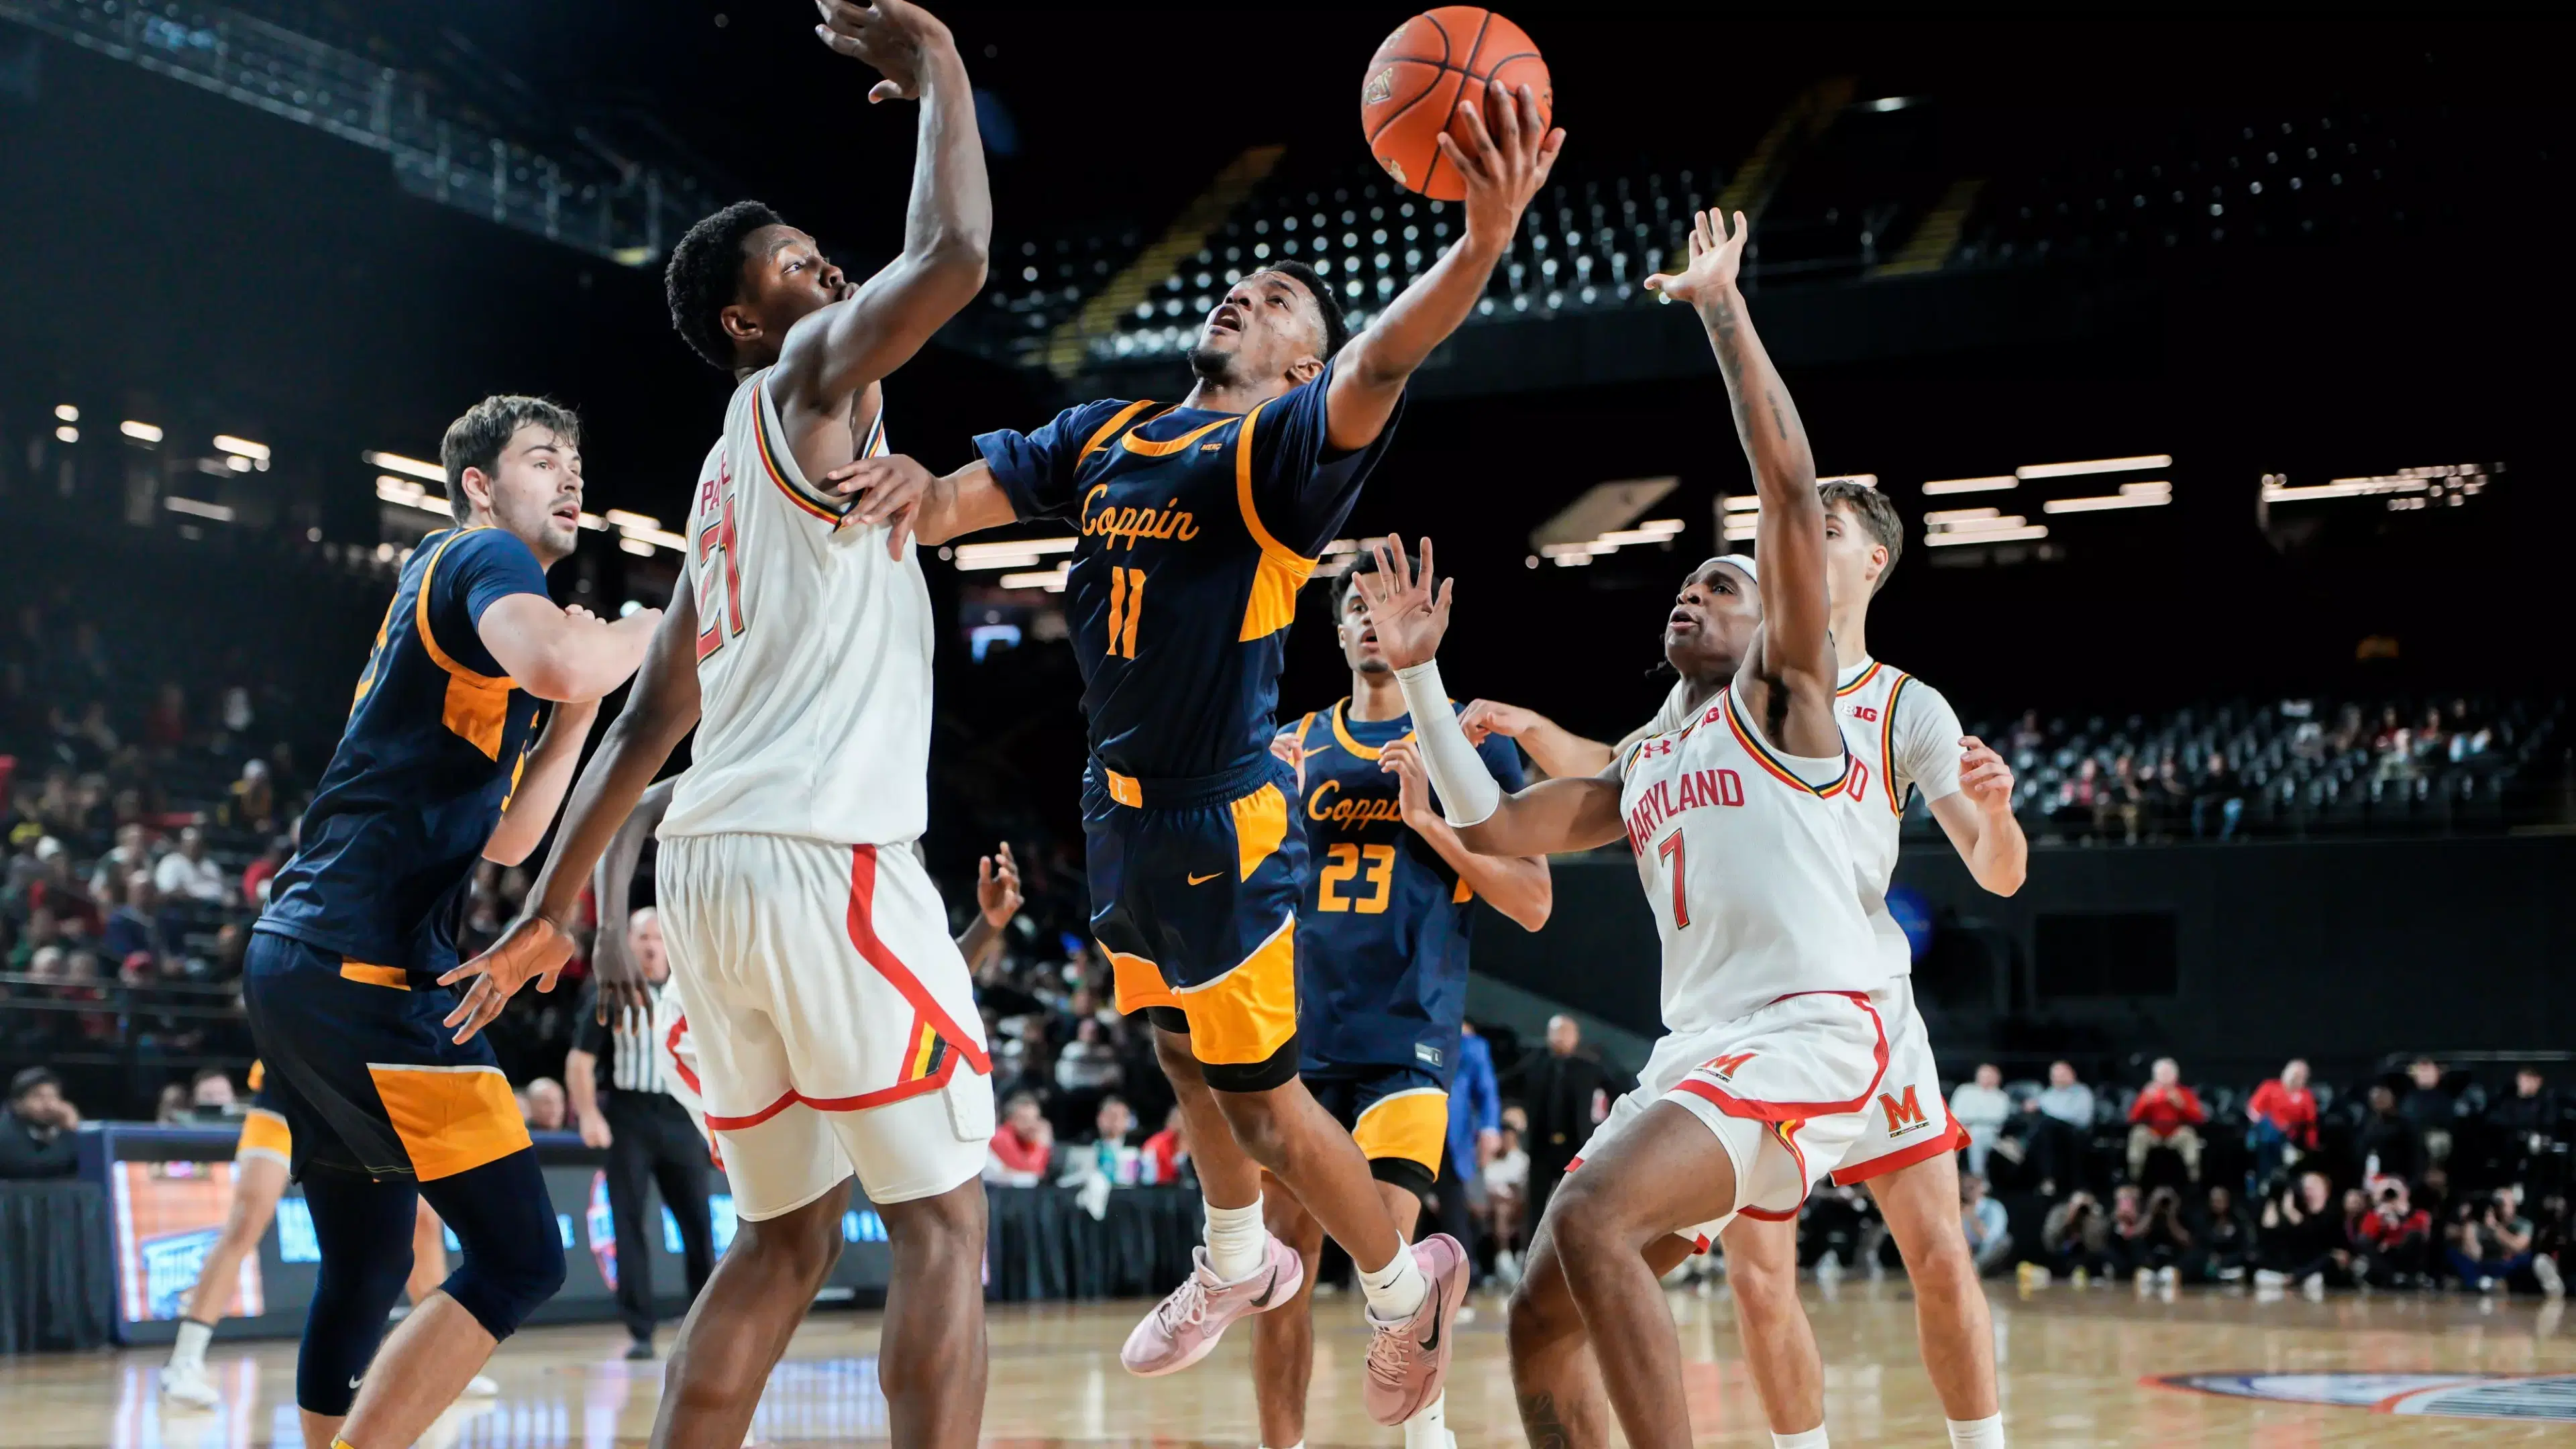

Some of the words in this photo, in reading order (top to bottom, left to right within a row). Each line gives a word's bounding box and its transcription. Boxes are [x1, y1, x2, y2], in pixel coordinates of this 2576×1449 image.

[1081, 484, 1200, 551] Coppin
[697, 493, 745, 666] 21
[1107, 566, 1146, 659] 11
[1308, 780, 1402, 831] Coppi
[1627, 769, 1745, 859] MARYLAND
[1318, 843, 1396, 914] 23
[1658, 827, 1690, 930] 7
[1877, 1083, 1927, 1132] M
